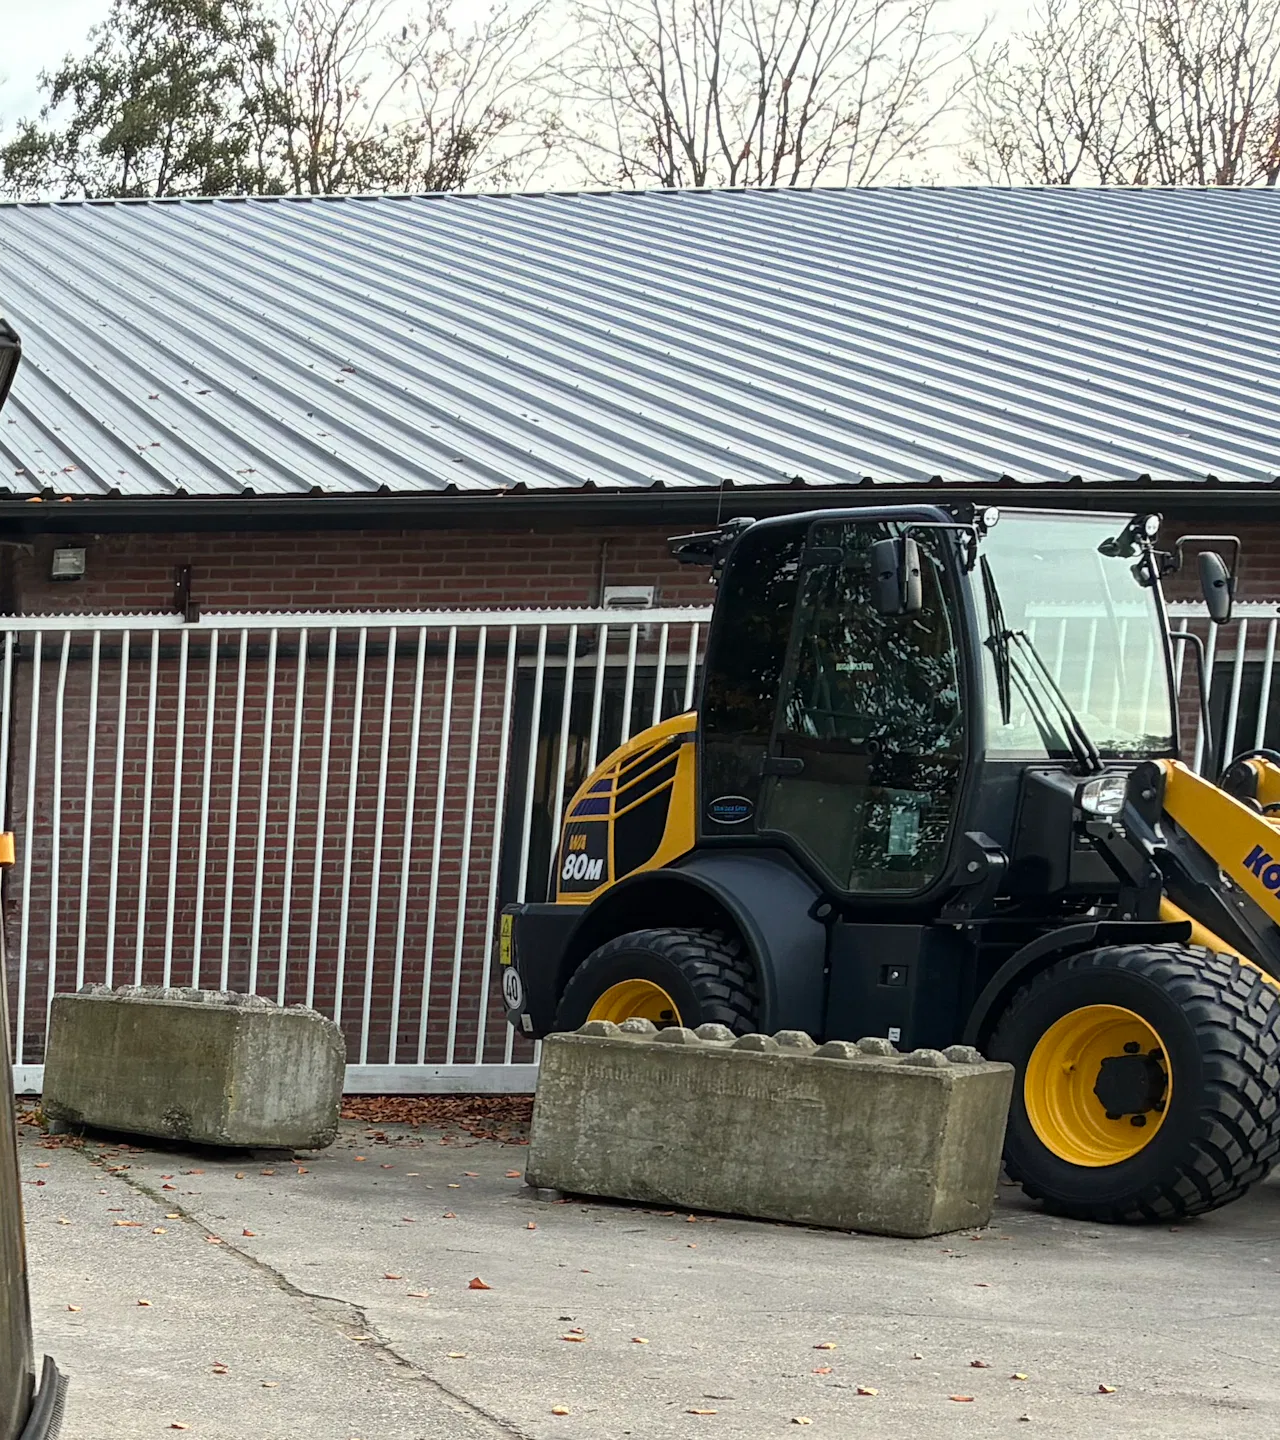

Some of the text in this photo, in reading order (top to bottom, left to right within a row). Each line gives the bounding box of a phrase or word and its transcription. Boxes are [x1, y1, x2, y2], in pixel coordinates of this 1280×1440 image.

[562, 853, 604, 880] 80M
[1242, 844, 1280, 900] KO
[506, 974, 518, 1001] 40
